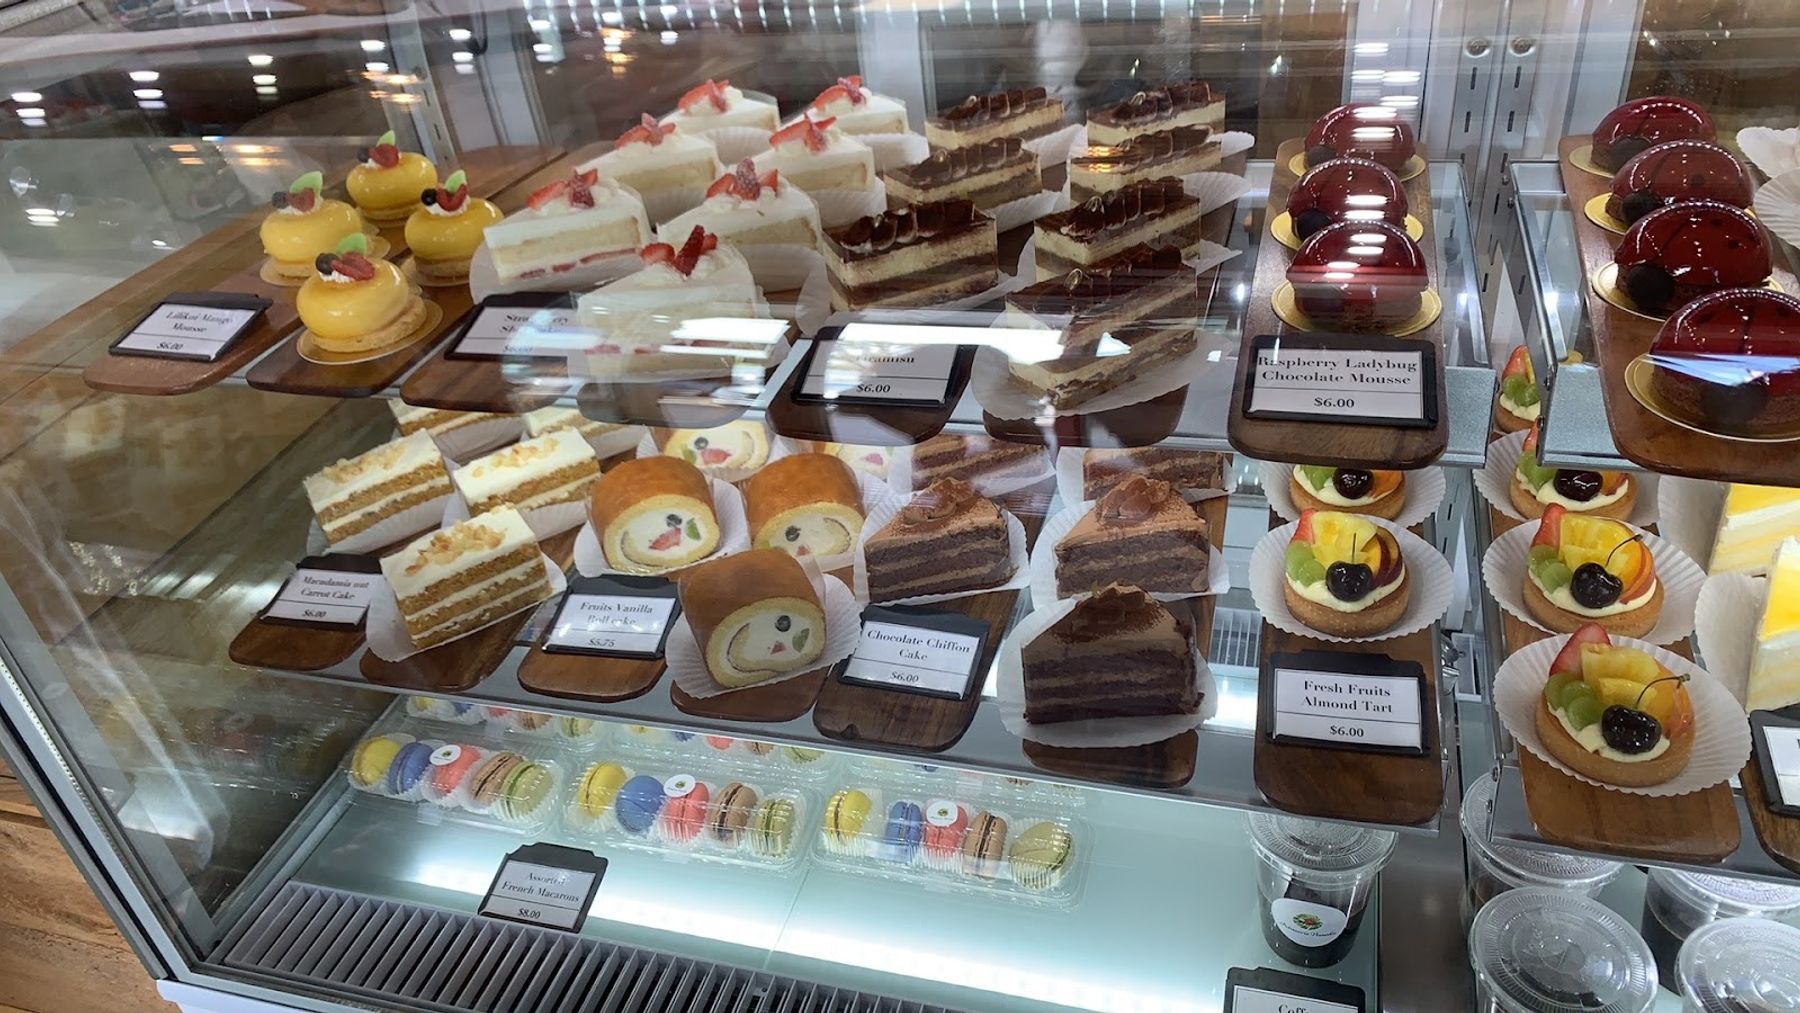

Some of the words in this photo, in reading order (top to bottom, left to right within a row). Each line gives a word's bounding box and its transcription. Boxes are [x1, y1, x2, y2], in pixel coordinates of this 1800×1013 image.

[173, 322, 208, 332] Mousse
[1258, 356, 1339, 371] Raspberry
[1346, 358, 1418, 372] Ladybug
[1262, 371, 1344, 382] Chocolate
[1350, 373, 1412, 385] Mousse
[856, 383, 891, 393] $6.00
[1314, 397, 1355, 408] $6.00
[303, 576, 352, 587] Macadamia
[301, 588, 331, 598] Carrot
[332, 590, 356, 599] Cake
[302, 609, 327, 618] $6.00
[580, 602, 612, 611] Fruits
[616, 603, 654, 614] Vanilla
[867, 629, 924, 645] Chocolate
[926, 638, 971, 653] Chiffon
[899, 648, 929, 660] Cake
[891, 671, 919, 683] $6.00
[1304, 680, 1343, 694] Fresh
[1349, 684, 1391, 697] Fruits
[1302, 695, 1358, 710] Almond
[1361, 700, 1393, 713] Tart
[1329, 725, 1365, 738] $6.00
[501, 880, 534, 895] French
[537, 887, 580, 902] Macarons
[518, 907, 541, 919] $8.00
